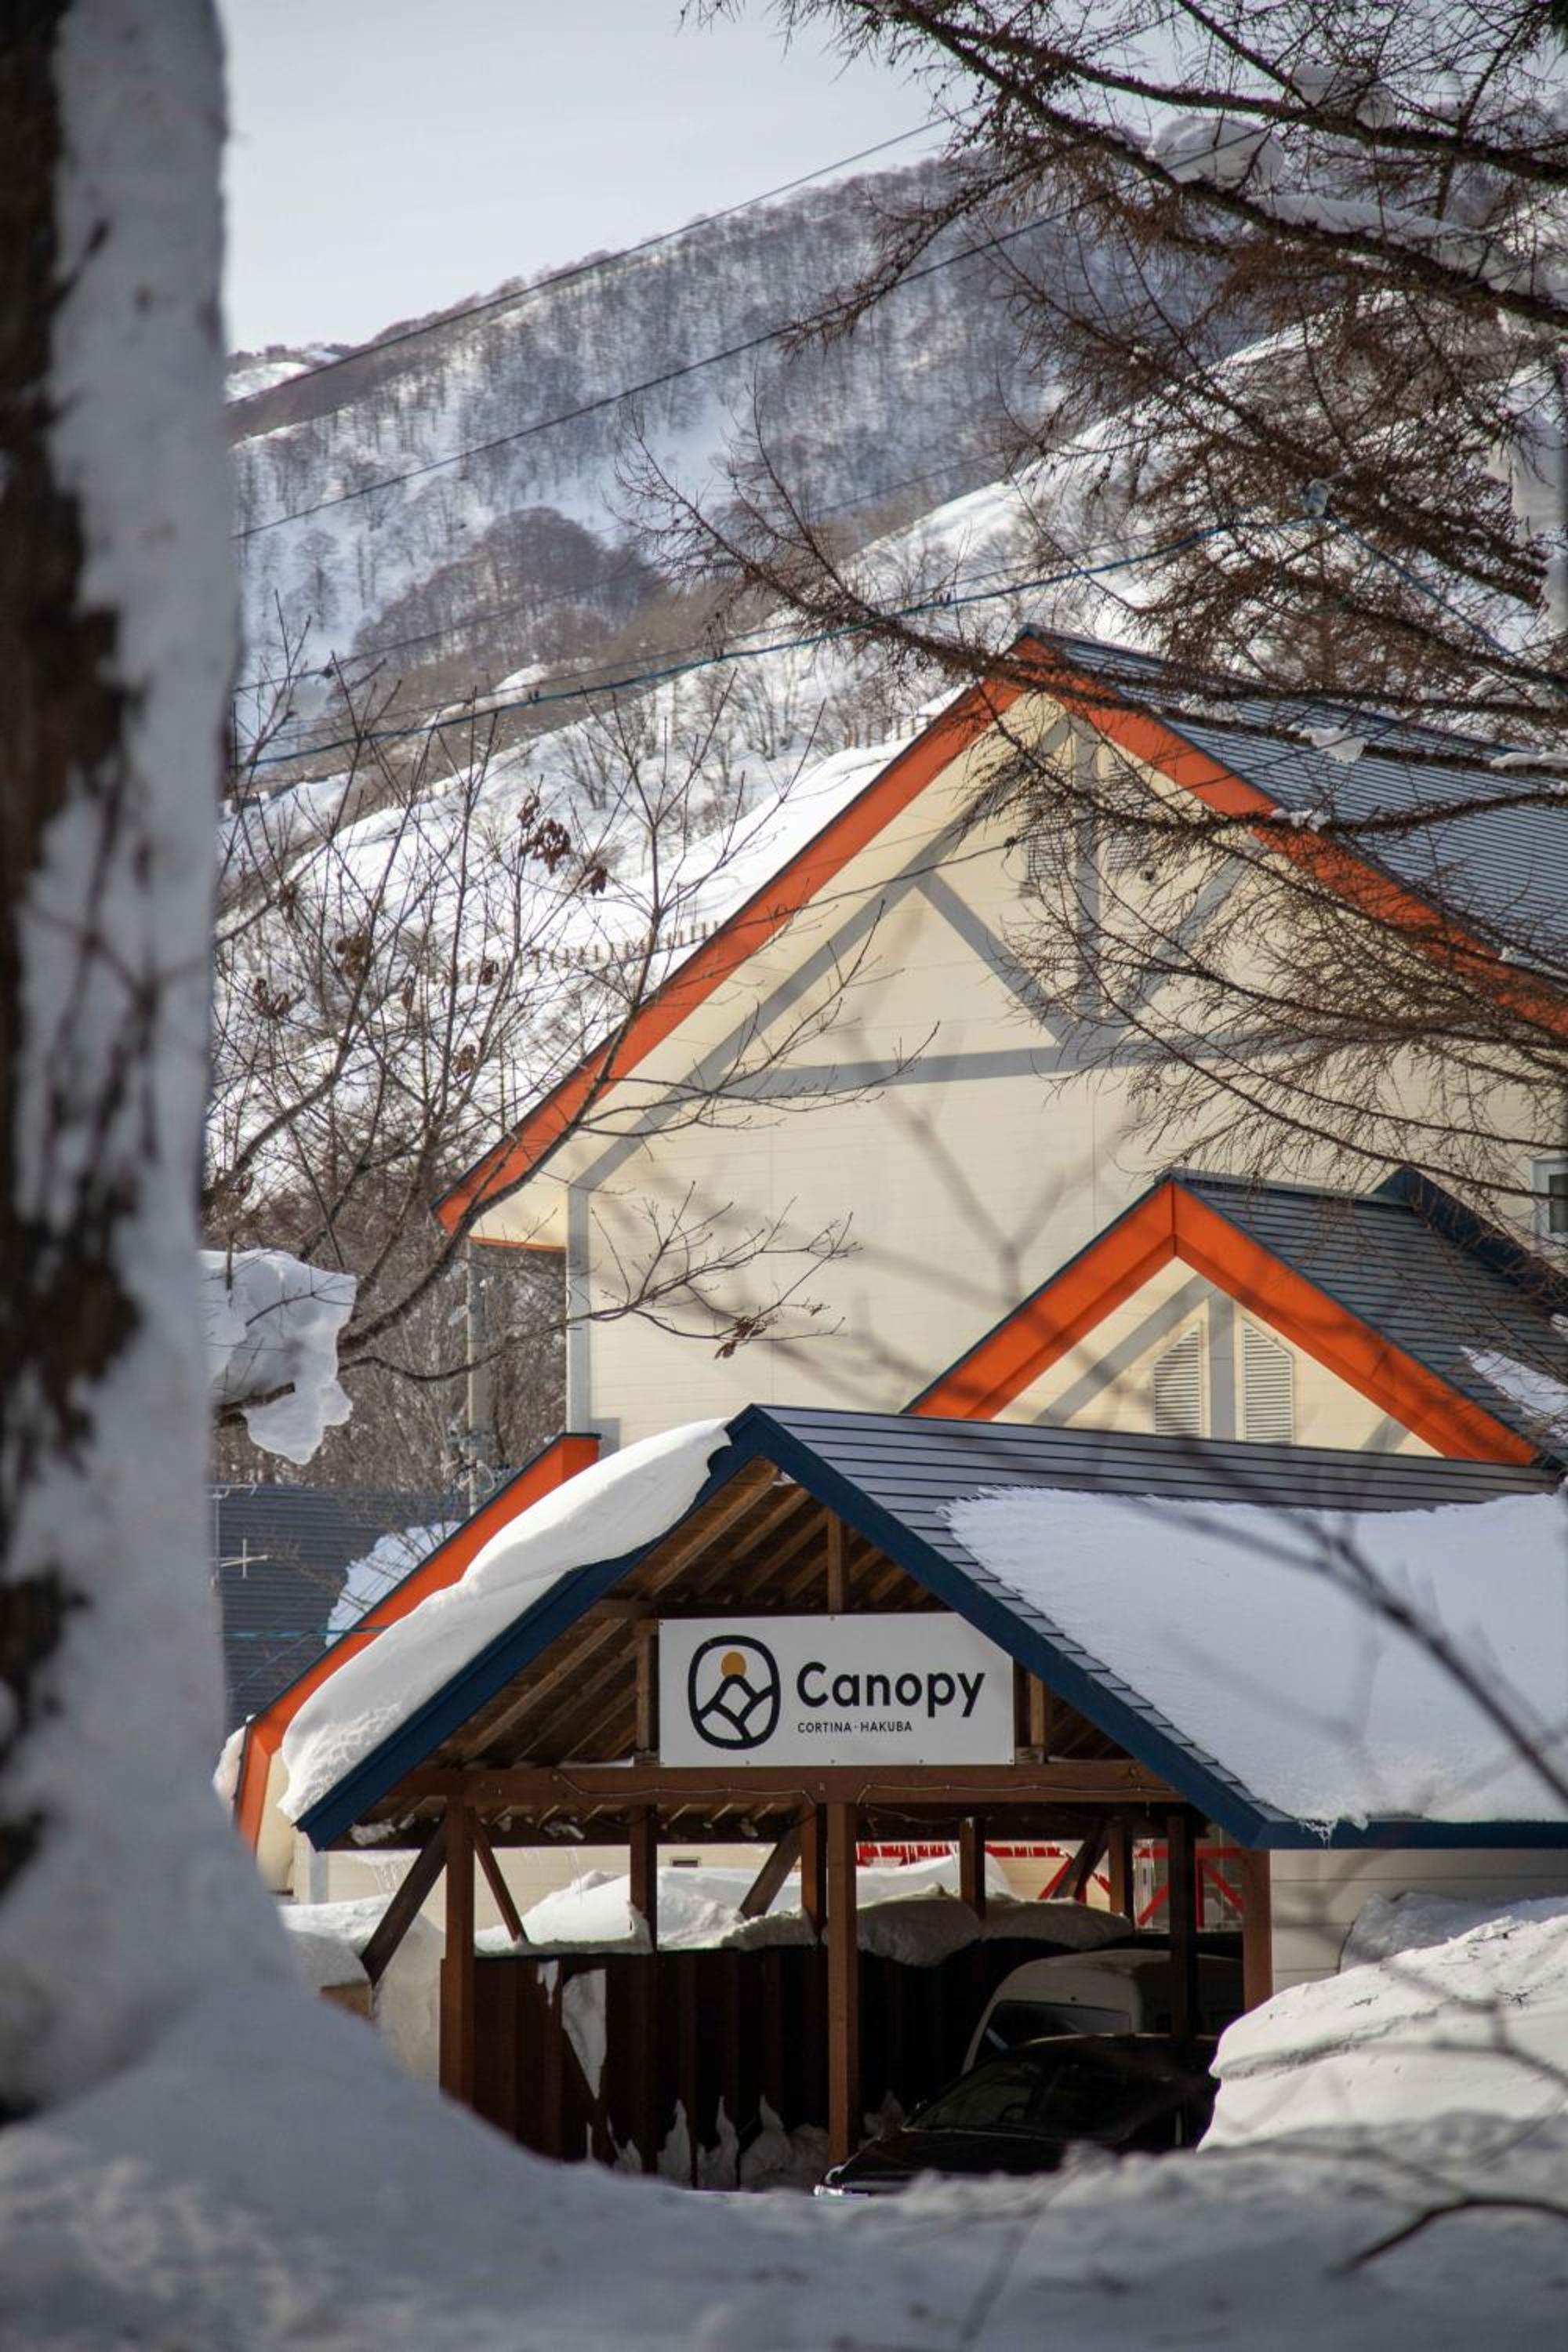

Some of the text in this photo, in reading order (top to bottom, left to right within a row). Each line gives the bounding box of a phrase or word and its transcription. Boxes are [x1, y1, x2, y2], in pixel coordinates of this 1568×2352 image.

[796, 1661, 985, 1719] Canopy
[797, 1720, 913, 1734] CORTINA HAKUBA
